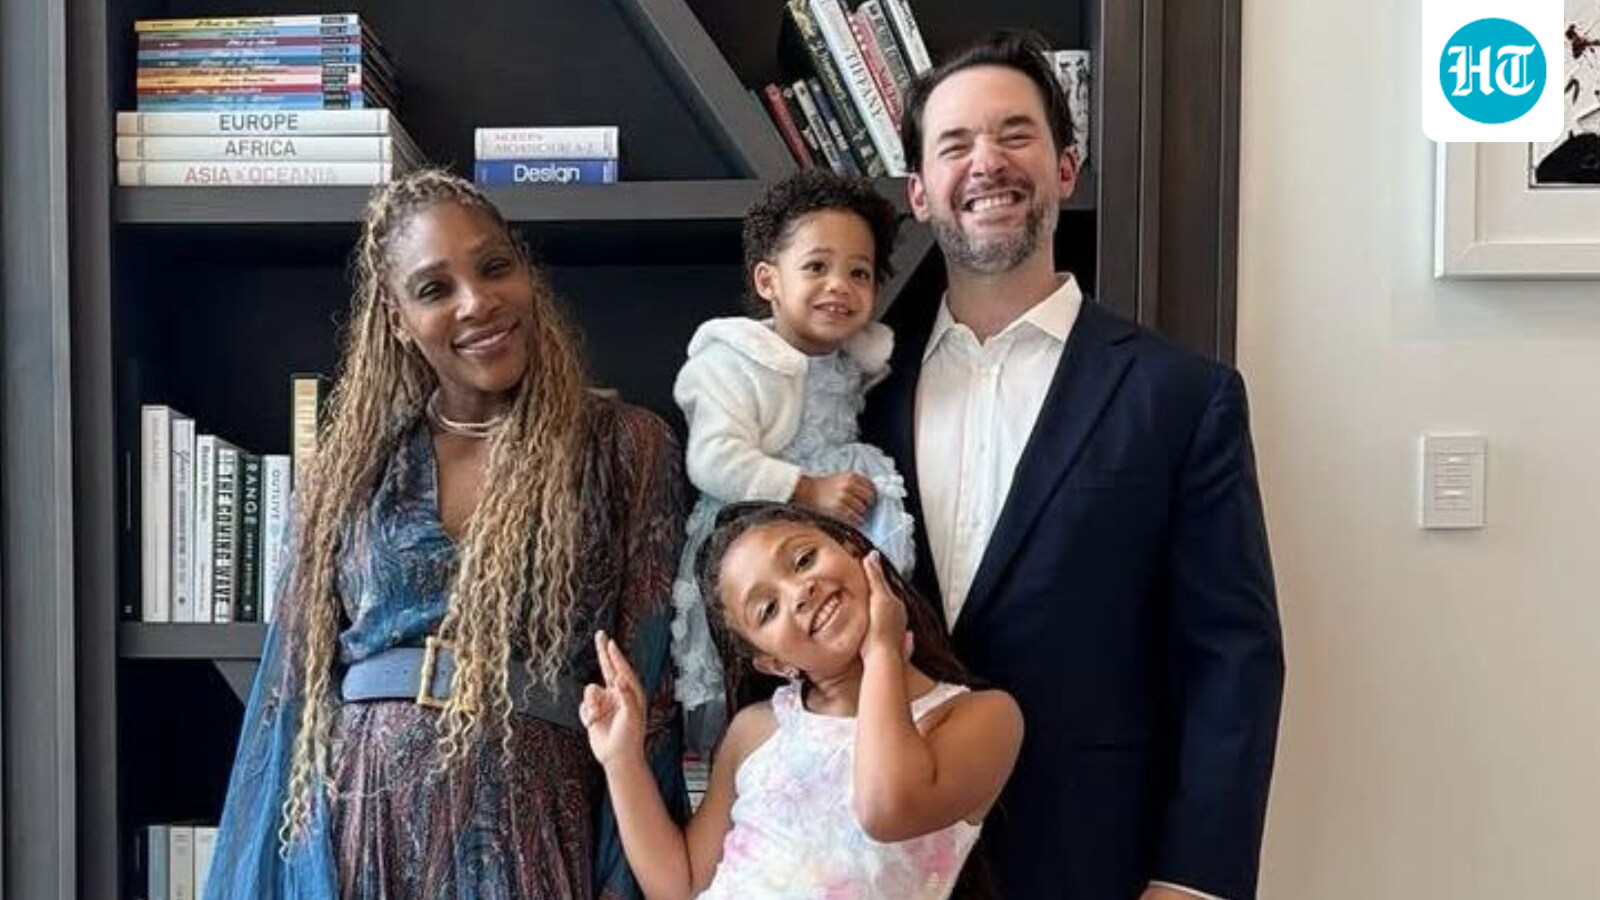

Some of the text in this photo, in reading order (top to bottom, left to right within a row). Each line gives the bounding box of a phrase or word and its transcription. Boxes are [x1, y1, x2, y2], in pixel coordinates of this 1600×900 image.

[219, 114, 298, 131] EUROPE
[224, 140, 297, 157] AFRICA
[185, 167, 232, 183] ASIA
[247, 166, 337, 183] OCEANIA
[513, 163, 580, 183] Design
[244, 462, 258, 525] RANGE
[270, 469, 281, 520] OUTLIVE
[214, 473, 233, 604] THE COMING WAVE
